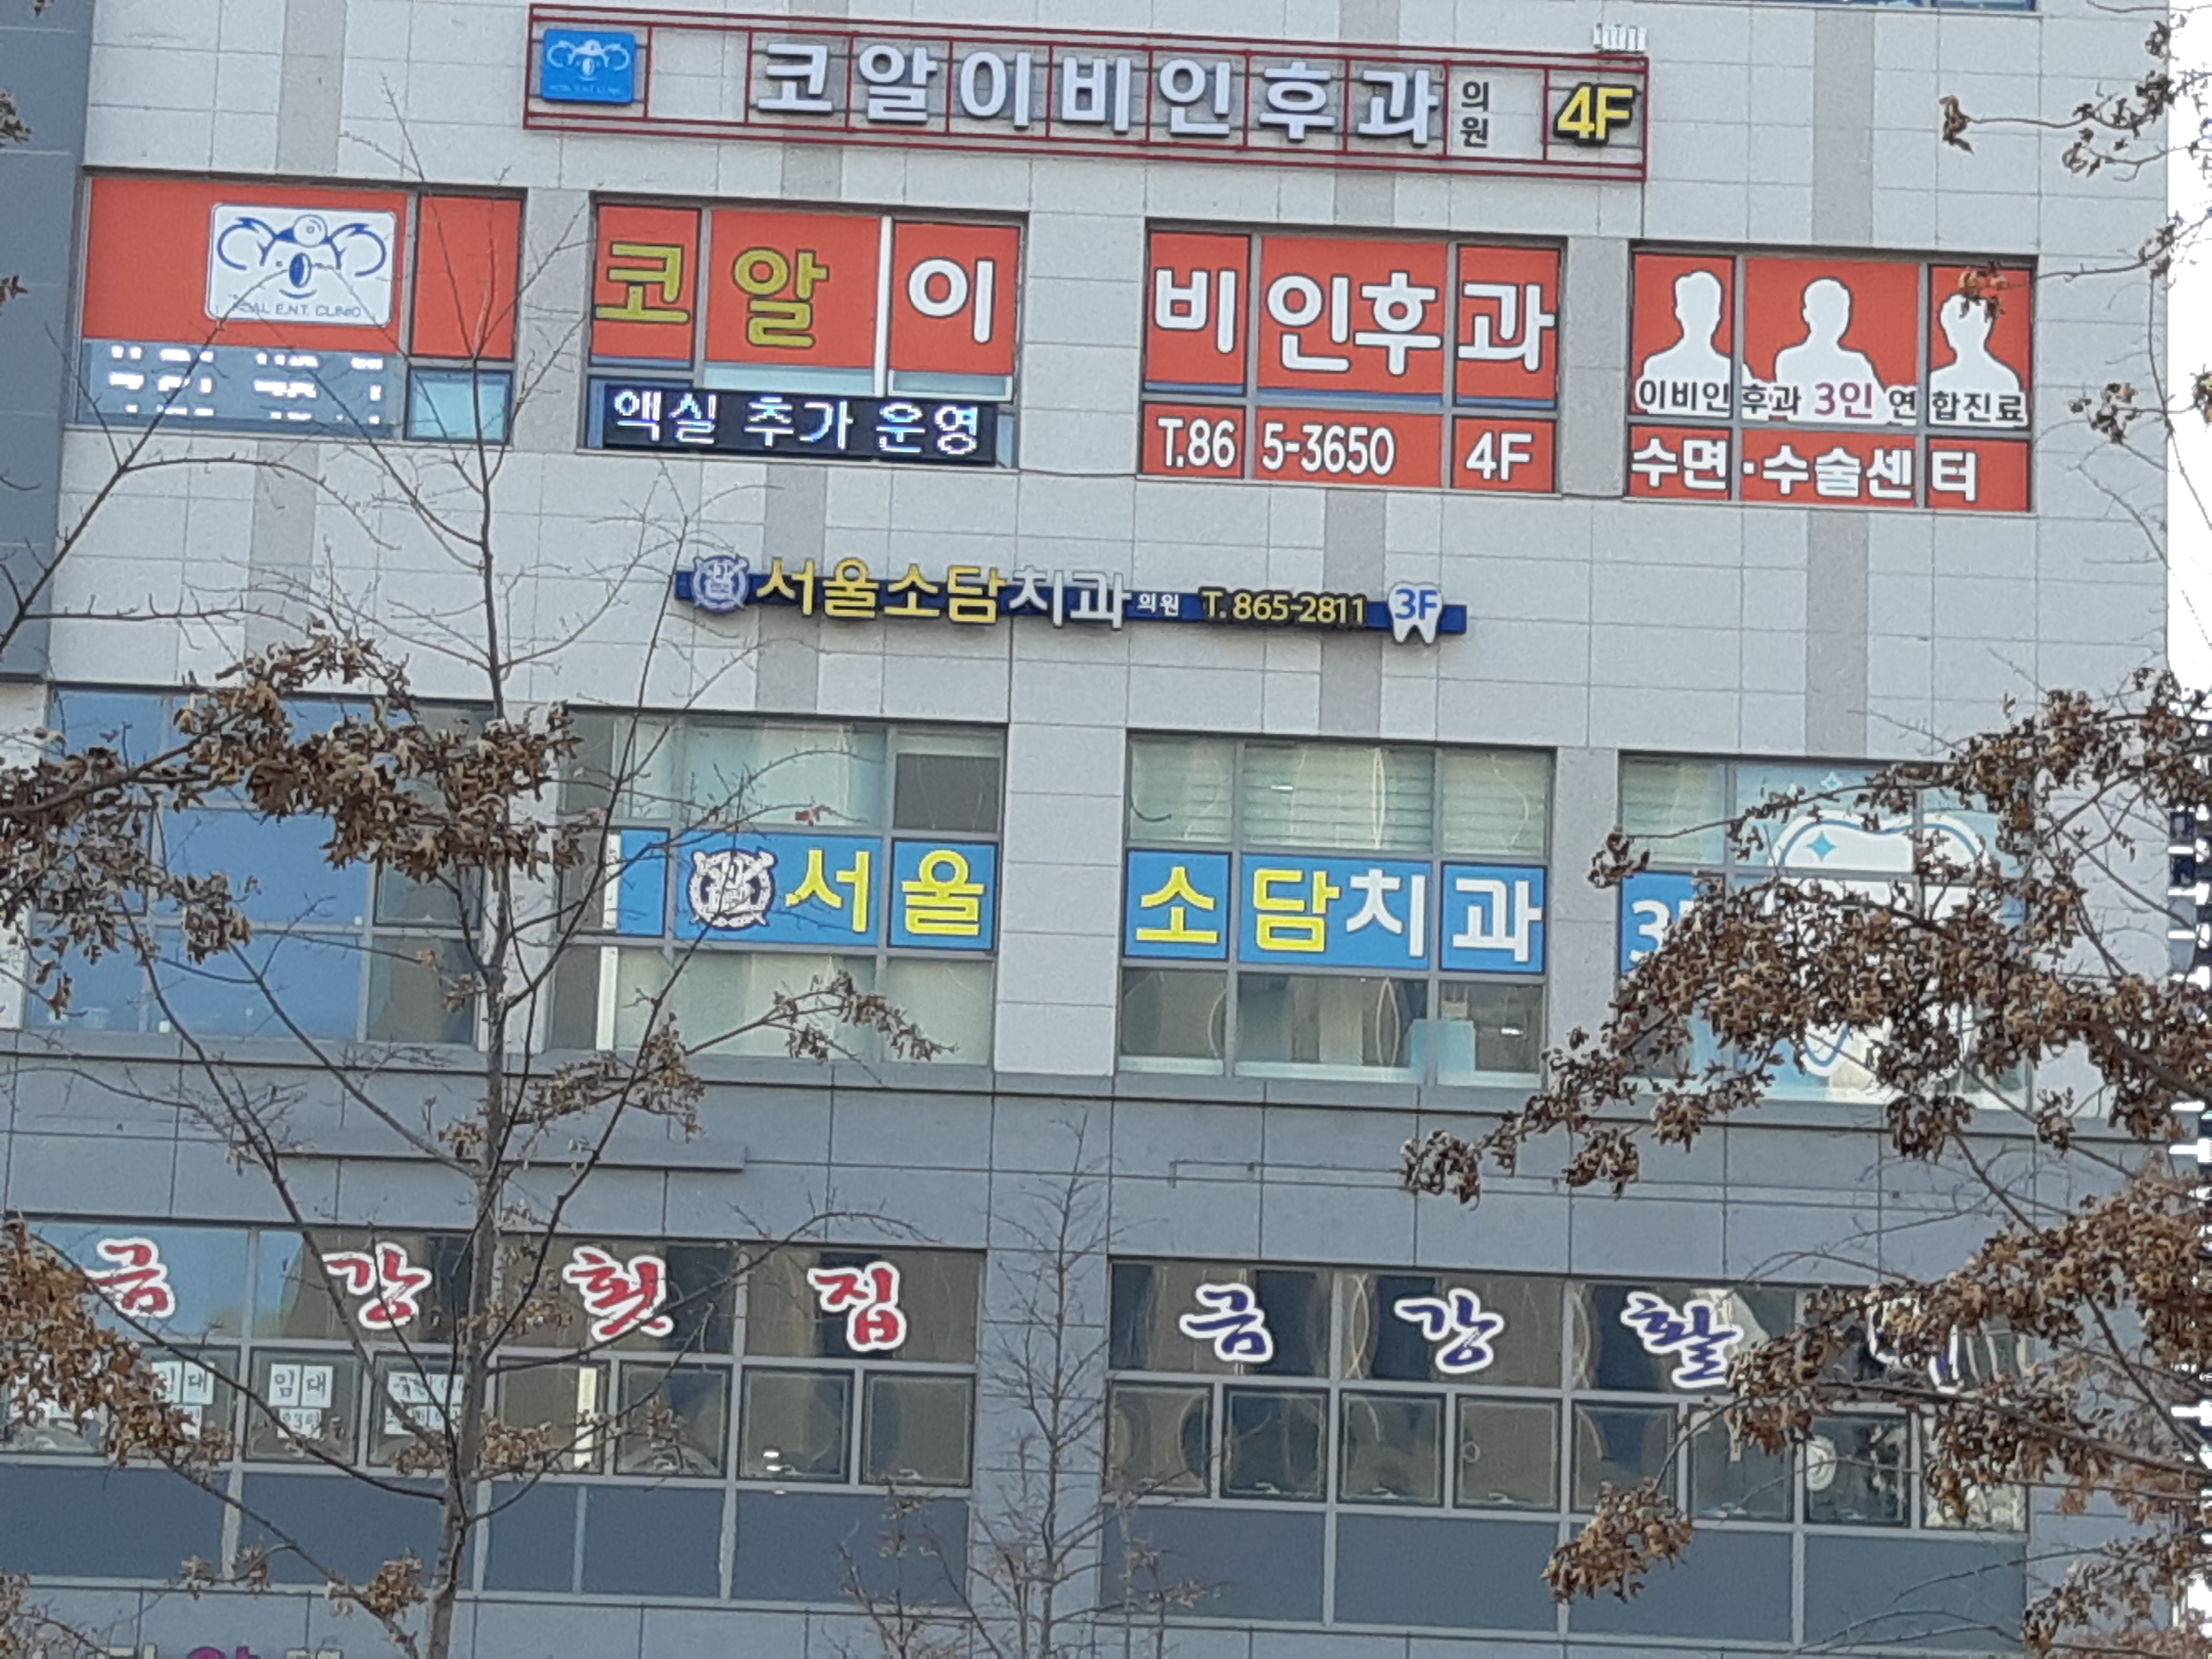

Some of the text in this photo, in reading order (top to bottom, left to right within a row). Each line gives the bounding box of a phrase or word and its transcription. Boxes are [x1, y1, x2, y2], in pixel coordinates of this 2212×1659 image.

[757, 42, 1634, 149] 코알이비인후과 의원 4F
[743, 396, 854, 451] 추가
[876, 402, 979, 456] 운영
[1638, 380, 1802, 416] 이비인후과
[1814, 381, 1875, 420] 3인
[1466, 431, 1535, 481] 4F
[755, 557, 1132, 630] 서울소담치과
[1136, 592, 1179, 617] 의원
[1395, 588, 1438, 621] 3F
[784, 848, 986, 937] 서울
[1135, 865, 1543, 962] 소담치과
[274, 1368, 327, 1400] 임대
